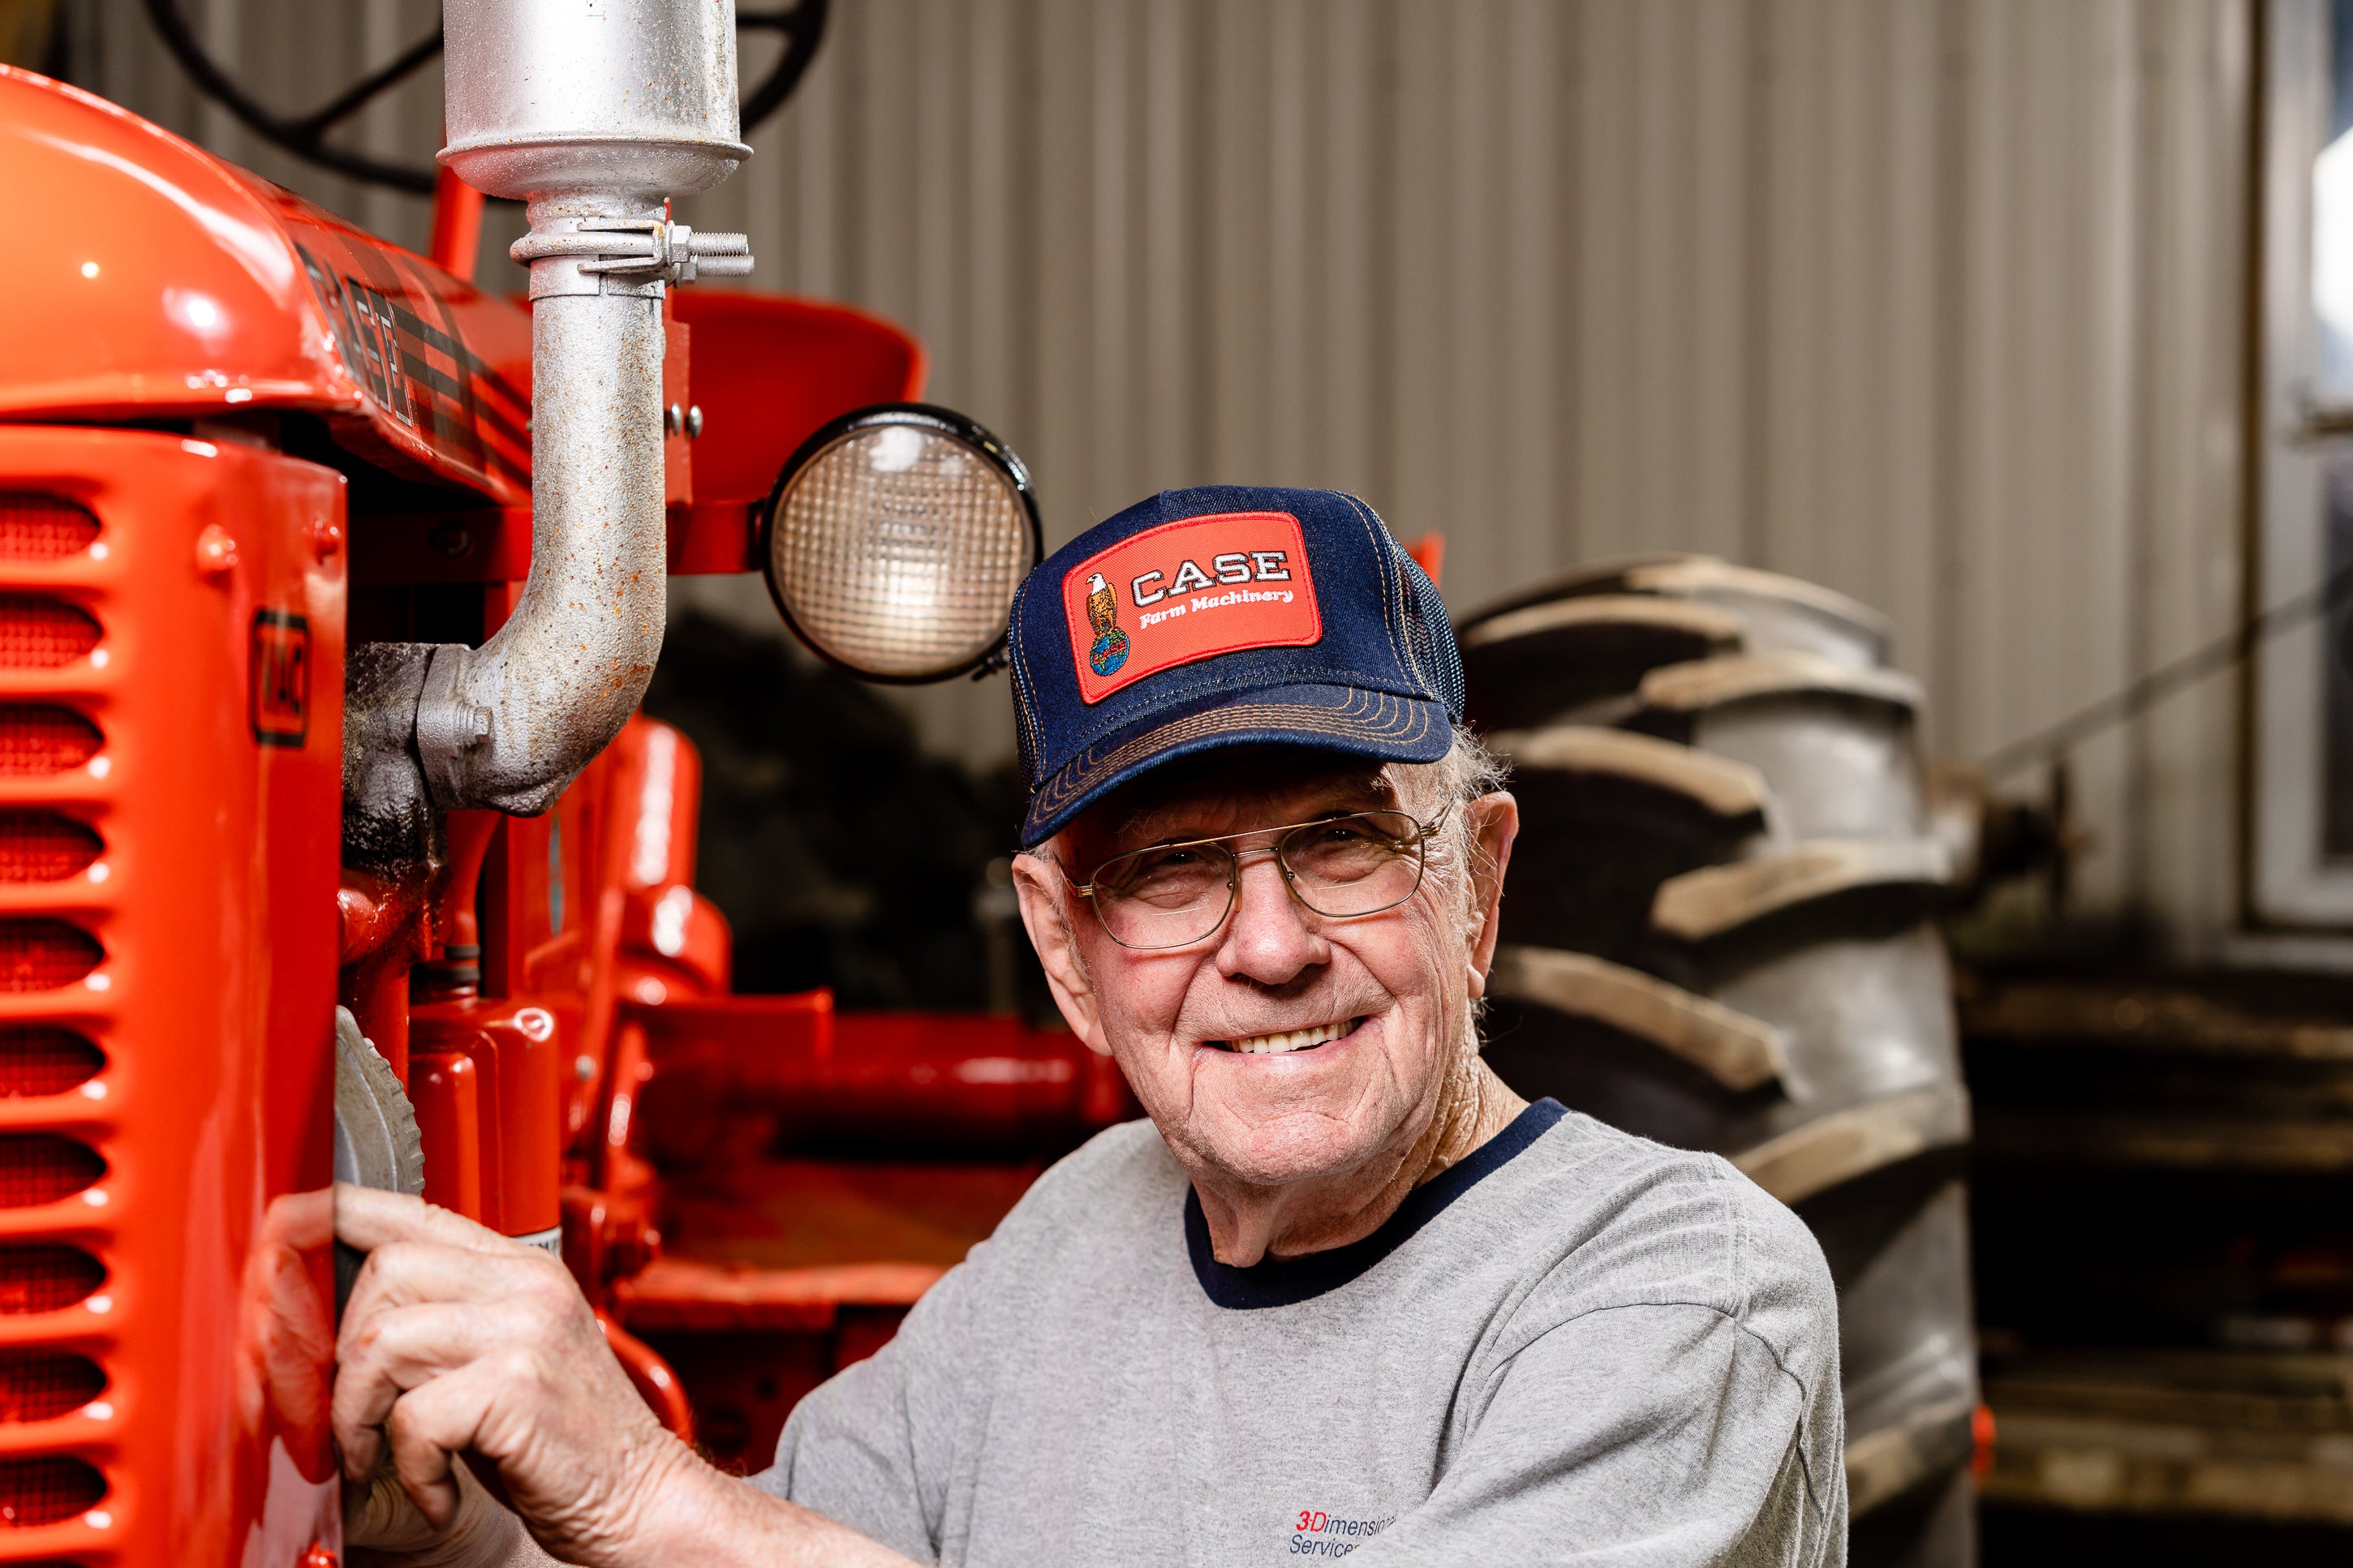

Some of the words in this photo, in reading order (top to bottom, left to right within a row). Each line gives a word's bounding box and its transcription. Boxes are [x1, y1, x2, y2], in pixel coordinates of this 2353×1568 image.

[1130, 551, 1292, 608] CASE
[1138, 604, 1187, 630] Farm
[1190, 590, 1294, 612] Machinery
